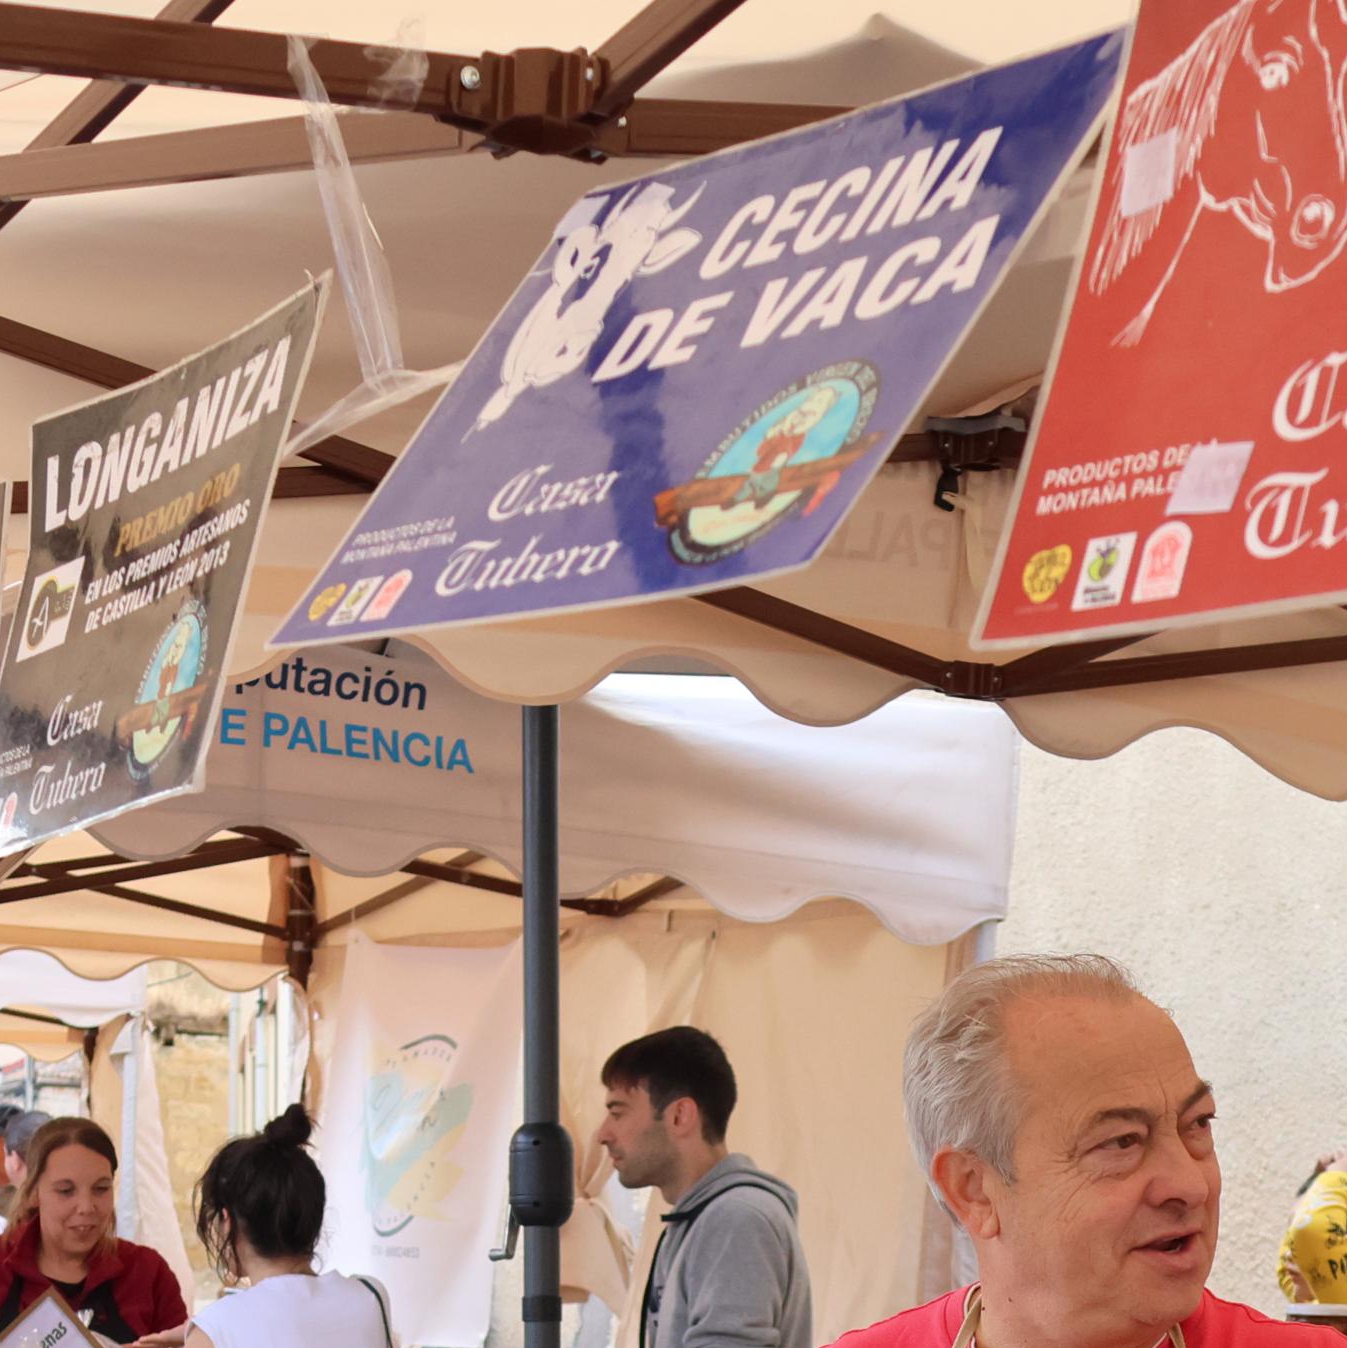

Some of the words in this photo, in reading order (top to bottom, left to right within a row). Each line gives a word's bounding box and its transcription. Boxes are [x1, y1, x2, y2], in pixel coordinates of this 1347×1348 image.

[699, 126, 1003, 281] CECINA
[592, 290, 733, 384] DE
[739, 214, 1000, 352] VACA
[44, 334, 292, 533] LONGANIZA
[487, 462, 622, 522] Casa
[1035, 479, 1128, 516] MONTAÑA
[1042, 450, 1159, 490] PRODUCTOS
[114, 491, 196, 557] PREMIO
[197, 462, 241, 513] ORO
[84, 581, 102, 605] EN
[102, 570, 126, 598] LOS
[125, 540, 181, 588] PREMIOS
[179, 498, 251, 558] ARTESANOS
[434, 533, 623, 597] Tubero
[84, 607, 102, 634] DE
[102, 582, 155, 625] CASTILLA
[156, 577, 169, 601] Y
[197, 540, 230, 579] 2013
[46, 694, 104, 747] Casa
[219, 707, 248, 746] E
[262, 711, 475, 774] PALENCIA
[29, 758, 107, 815] Tubero
